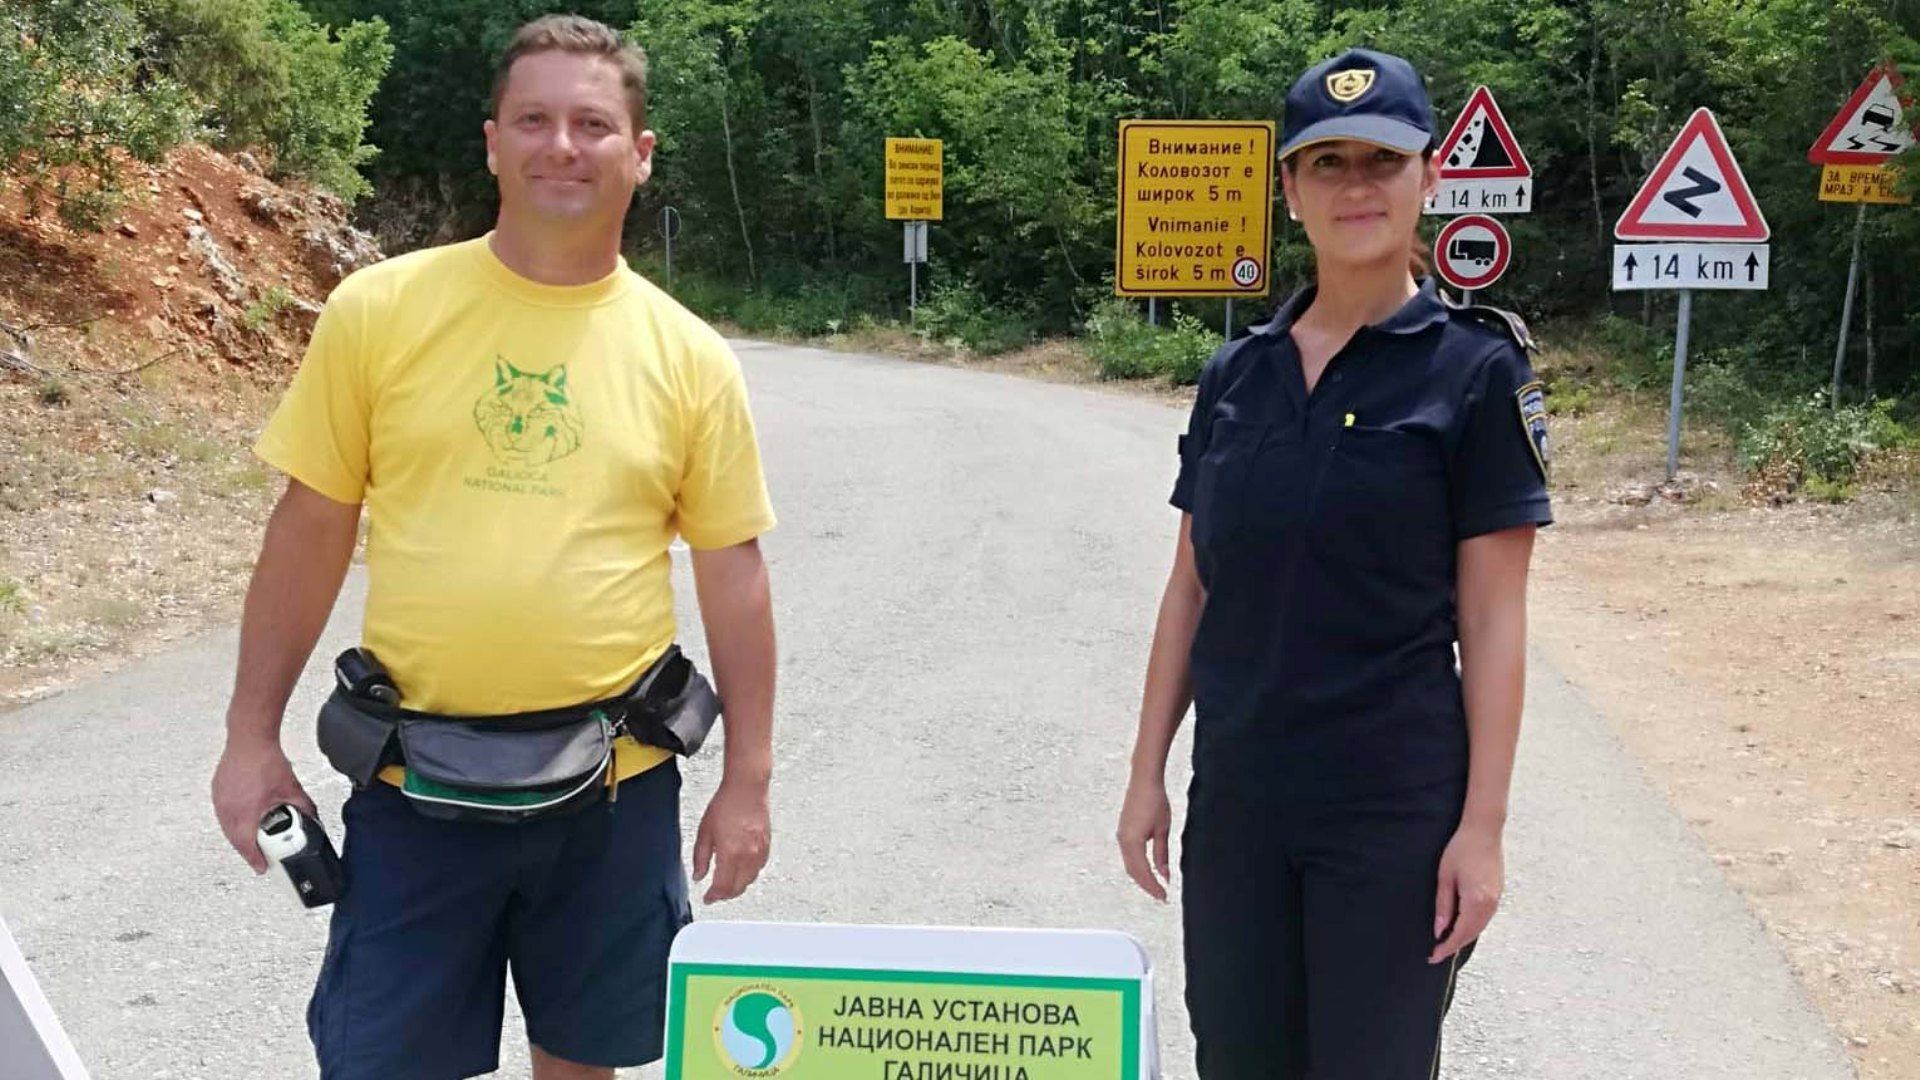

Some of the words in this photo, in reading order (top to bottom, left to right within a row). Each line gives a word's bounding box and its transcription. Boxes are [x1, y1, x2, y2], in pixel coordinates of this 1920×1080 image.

[1149, 139, 1242, 154] Внимание
[1138, 161, 1230, 178] Коловозот
[1244, 166, 1254, 178] е
[1826, 170, 1841, 182] ЗА
[1137, 189, 1195, 204] широк
[1208, 185, 1219, 201] 5
[1452, 189, 1469, 208] 14
[1481, 189, 1507, 208] km
[1863, 185, 1872, 196] И
[1148, 216, 1229, 232] Vnimanie
[1136, 241, 1224, 257] Kolovozot
[1235, 245, 1245, 257] e
[1136, 264, 1180, 280] širok
[1193, 264, 1203, 280] 5
[1210, 268, 1225, 280] m
[1237, 264, 1255, 280] 40
[1653, 253, 1679, 279] 14
[1697, 254, 1733, 279] km
[834, 996, 924, 1020] ЈАВНА
[933, 998, 1080, 1026] УСТАНОВА
[819, 1026, 1009, 1055] НАЦИОНАЛЕН
[1019, 1034, 1092, 1060] ПАРК
